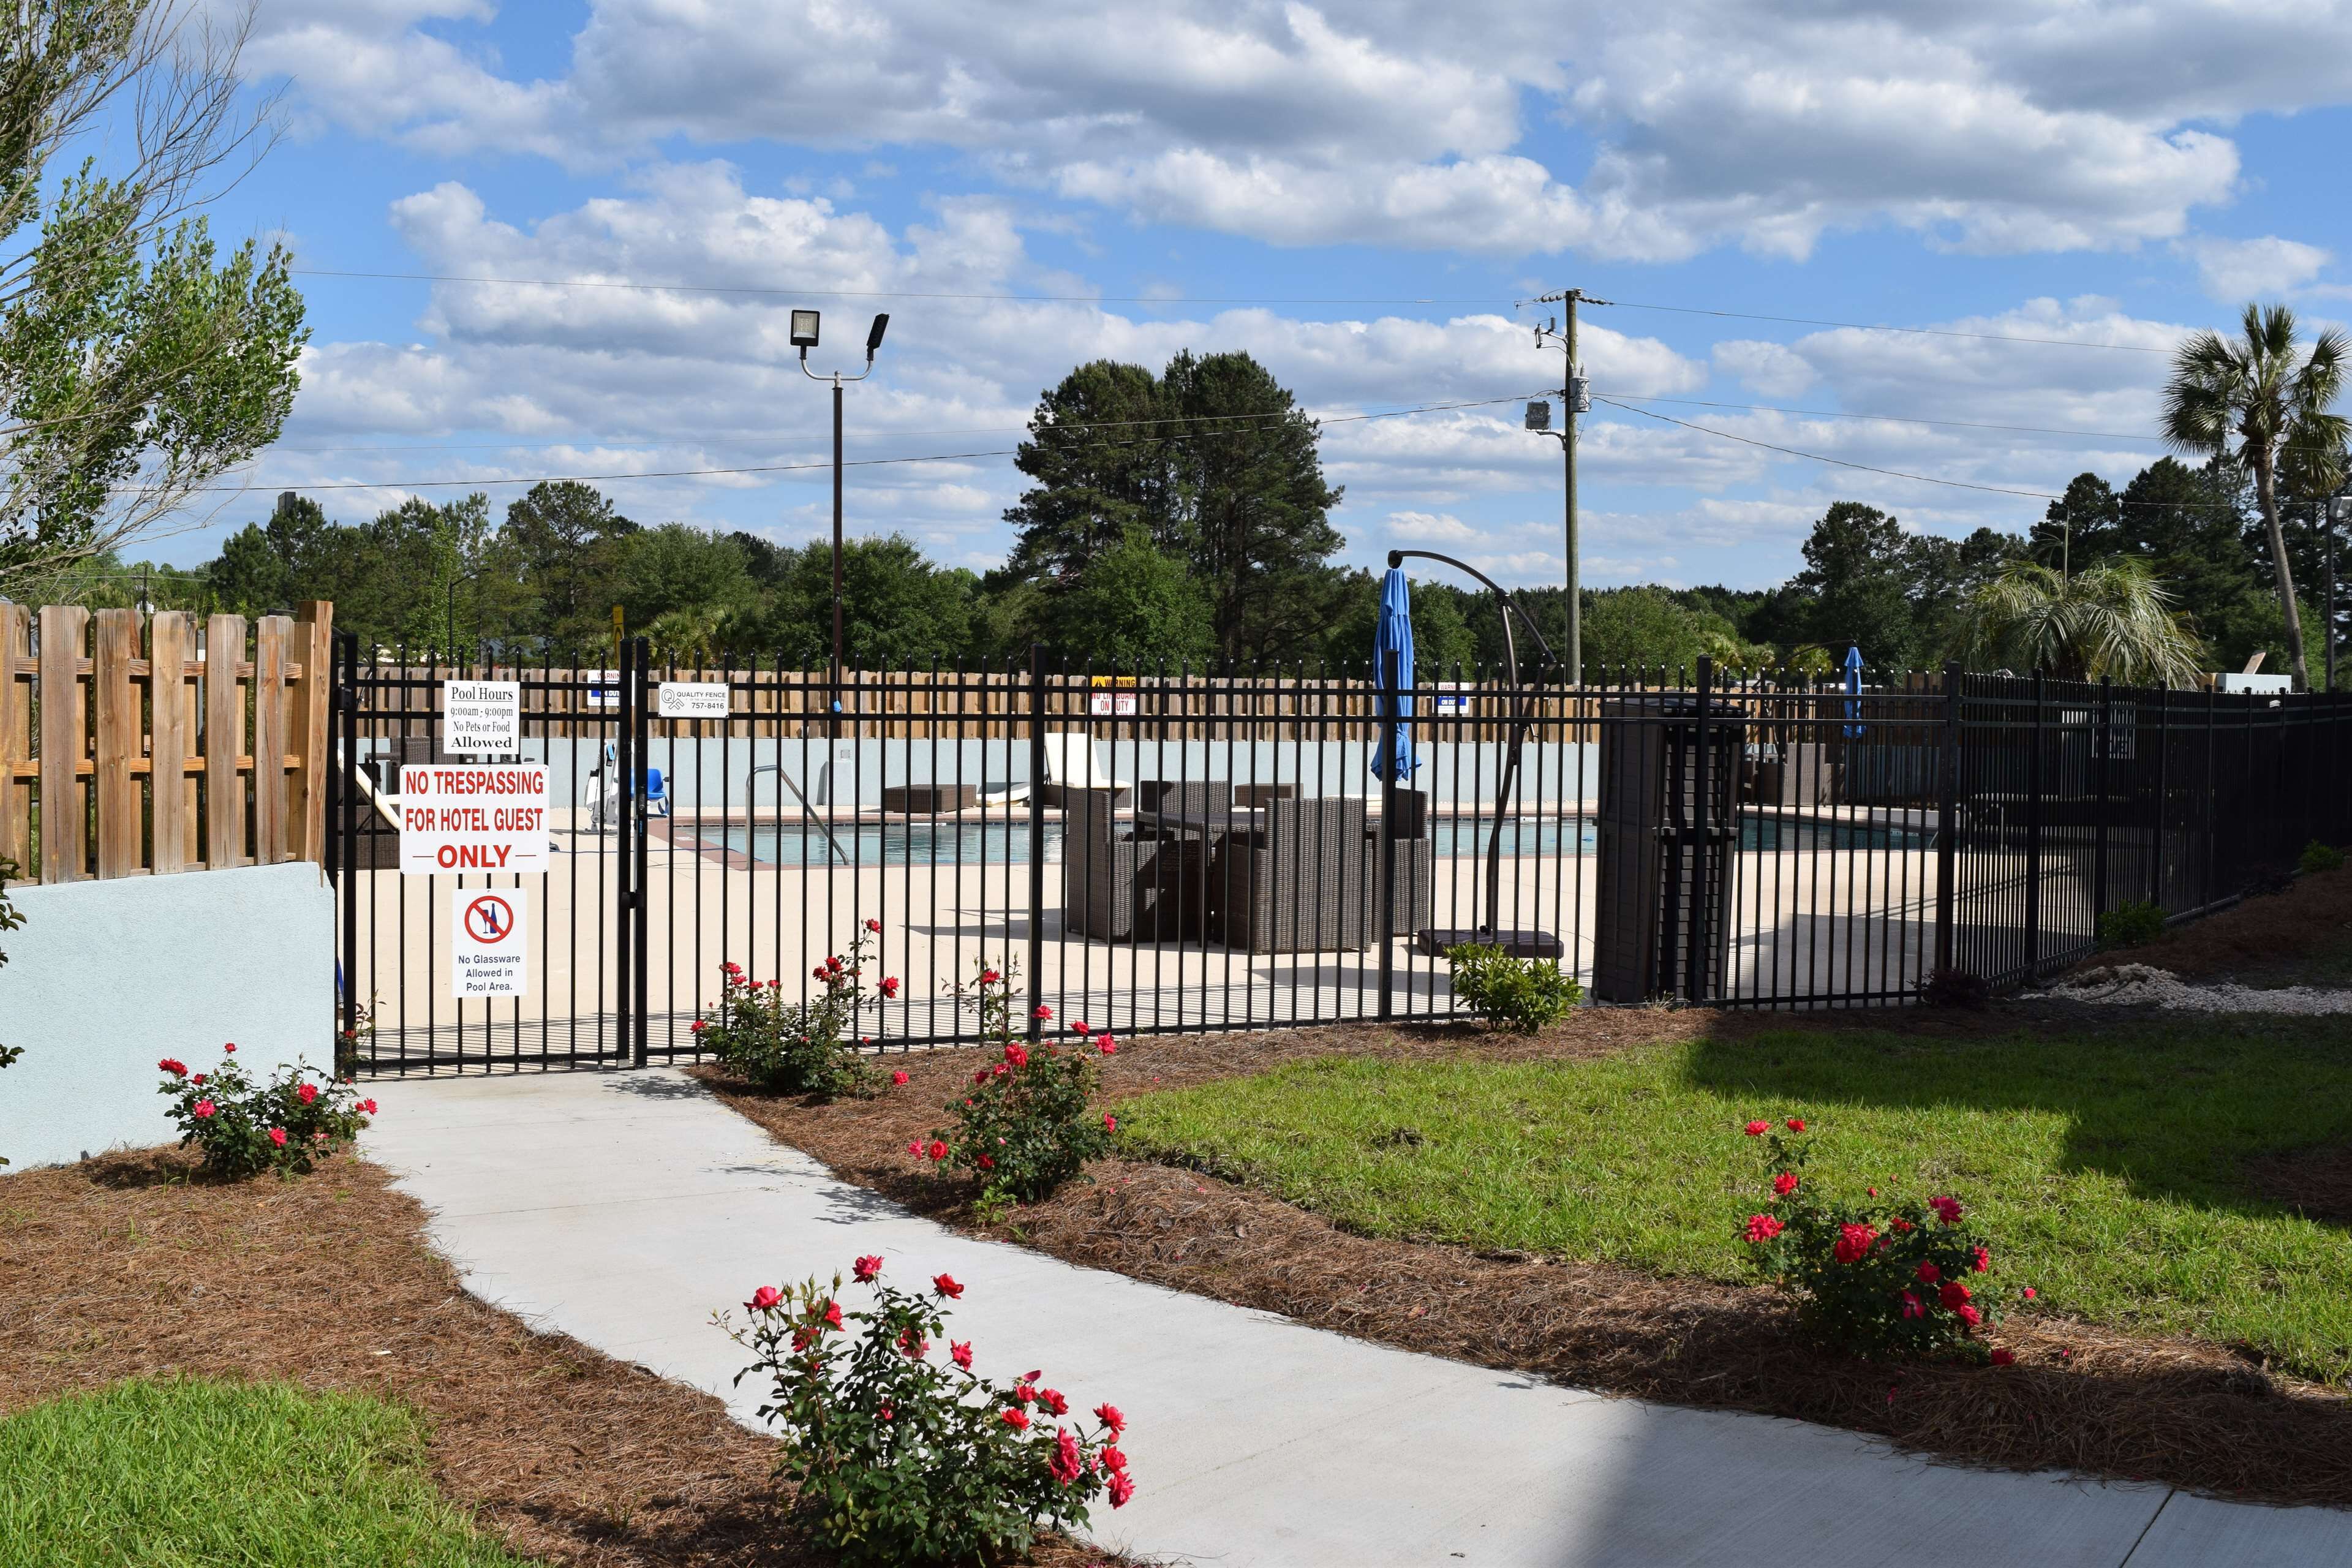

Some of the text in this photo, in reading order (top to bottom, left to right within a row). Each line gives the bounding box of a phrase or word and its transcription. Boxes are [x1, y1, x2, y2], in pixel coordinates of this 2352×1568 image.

[451, 687, 513, 700] Pool Hours
[1101, 701, 1129, 711] ON UTY
[451, 707, 478, 718] 9:00am
[484, 707, 513, 719] 9:00pm
[453, 721, 510, 732] No Pets or Food
[451, 736, 512, 748] Allowed
[406, 771, 543, 794] NO TRESPASSING
[406, 808, 543, 832] FOR HOTEL GUEST
[437, 845, 512, 869] ONLY
[458, 954, 521, 964] No Glassware
[466, 968, 513, 978] Allowed in
[466, 982, 513, 991] Pool Area.
